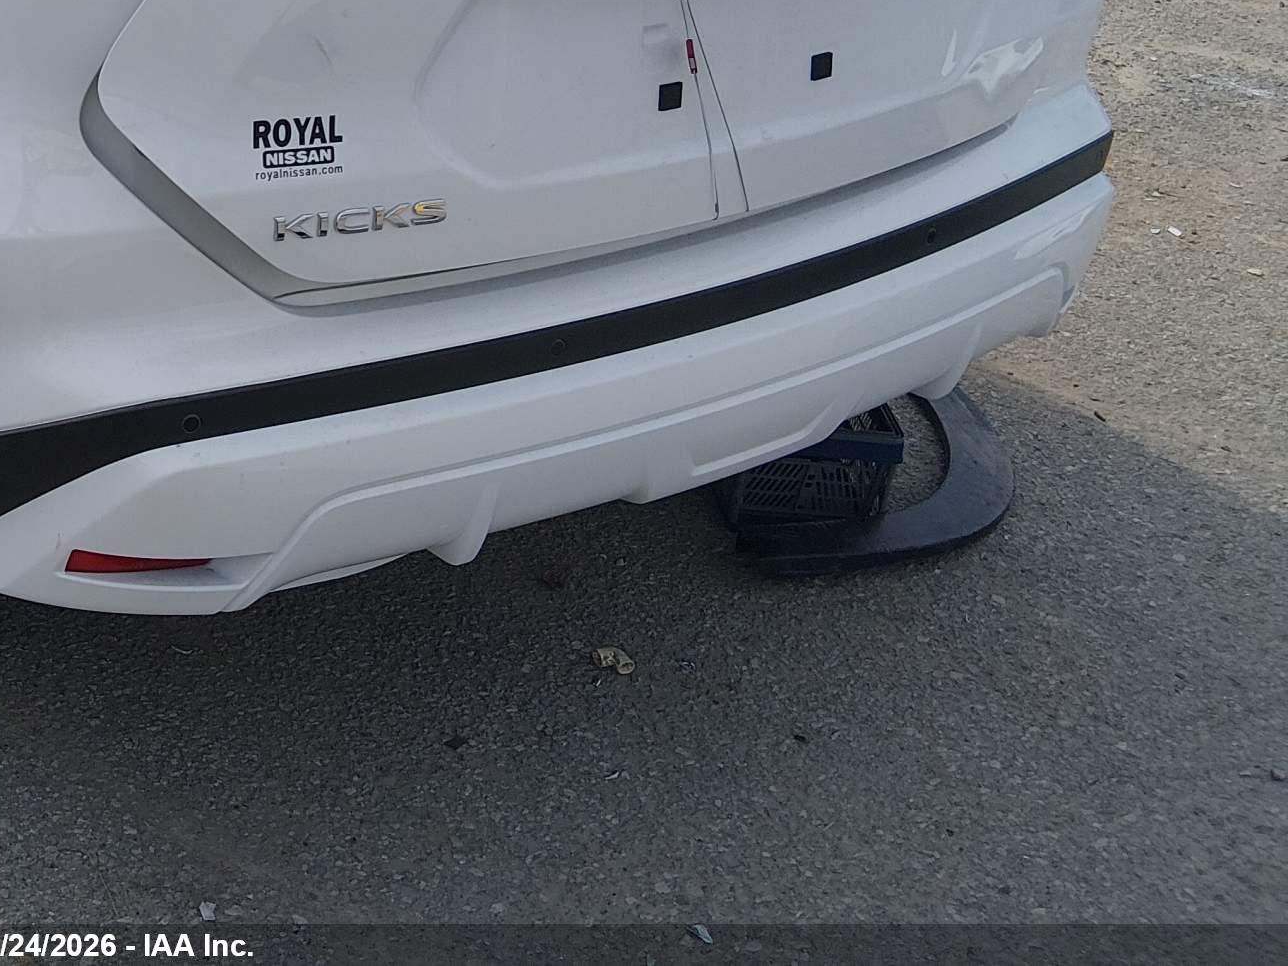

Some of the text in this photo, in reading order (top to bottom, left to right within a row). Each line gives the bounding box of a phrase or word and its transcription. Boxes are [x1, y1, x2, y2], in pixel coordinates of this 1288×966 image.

[253, 115, 343, 149] ROYAL
[265, 148, 332, 166] NISSAN
[255, 165, 343, 182] royalnissan.com
[273, 198, 447, 241] KICKS
